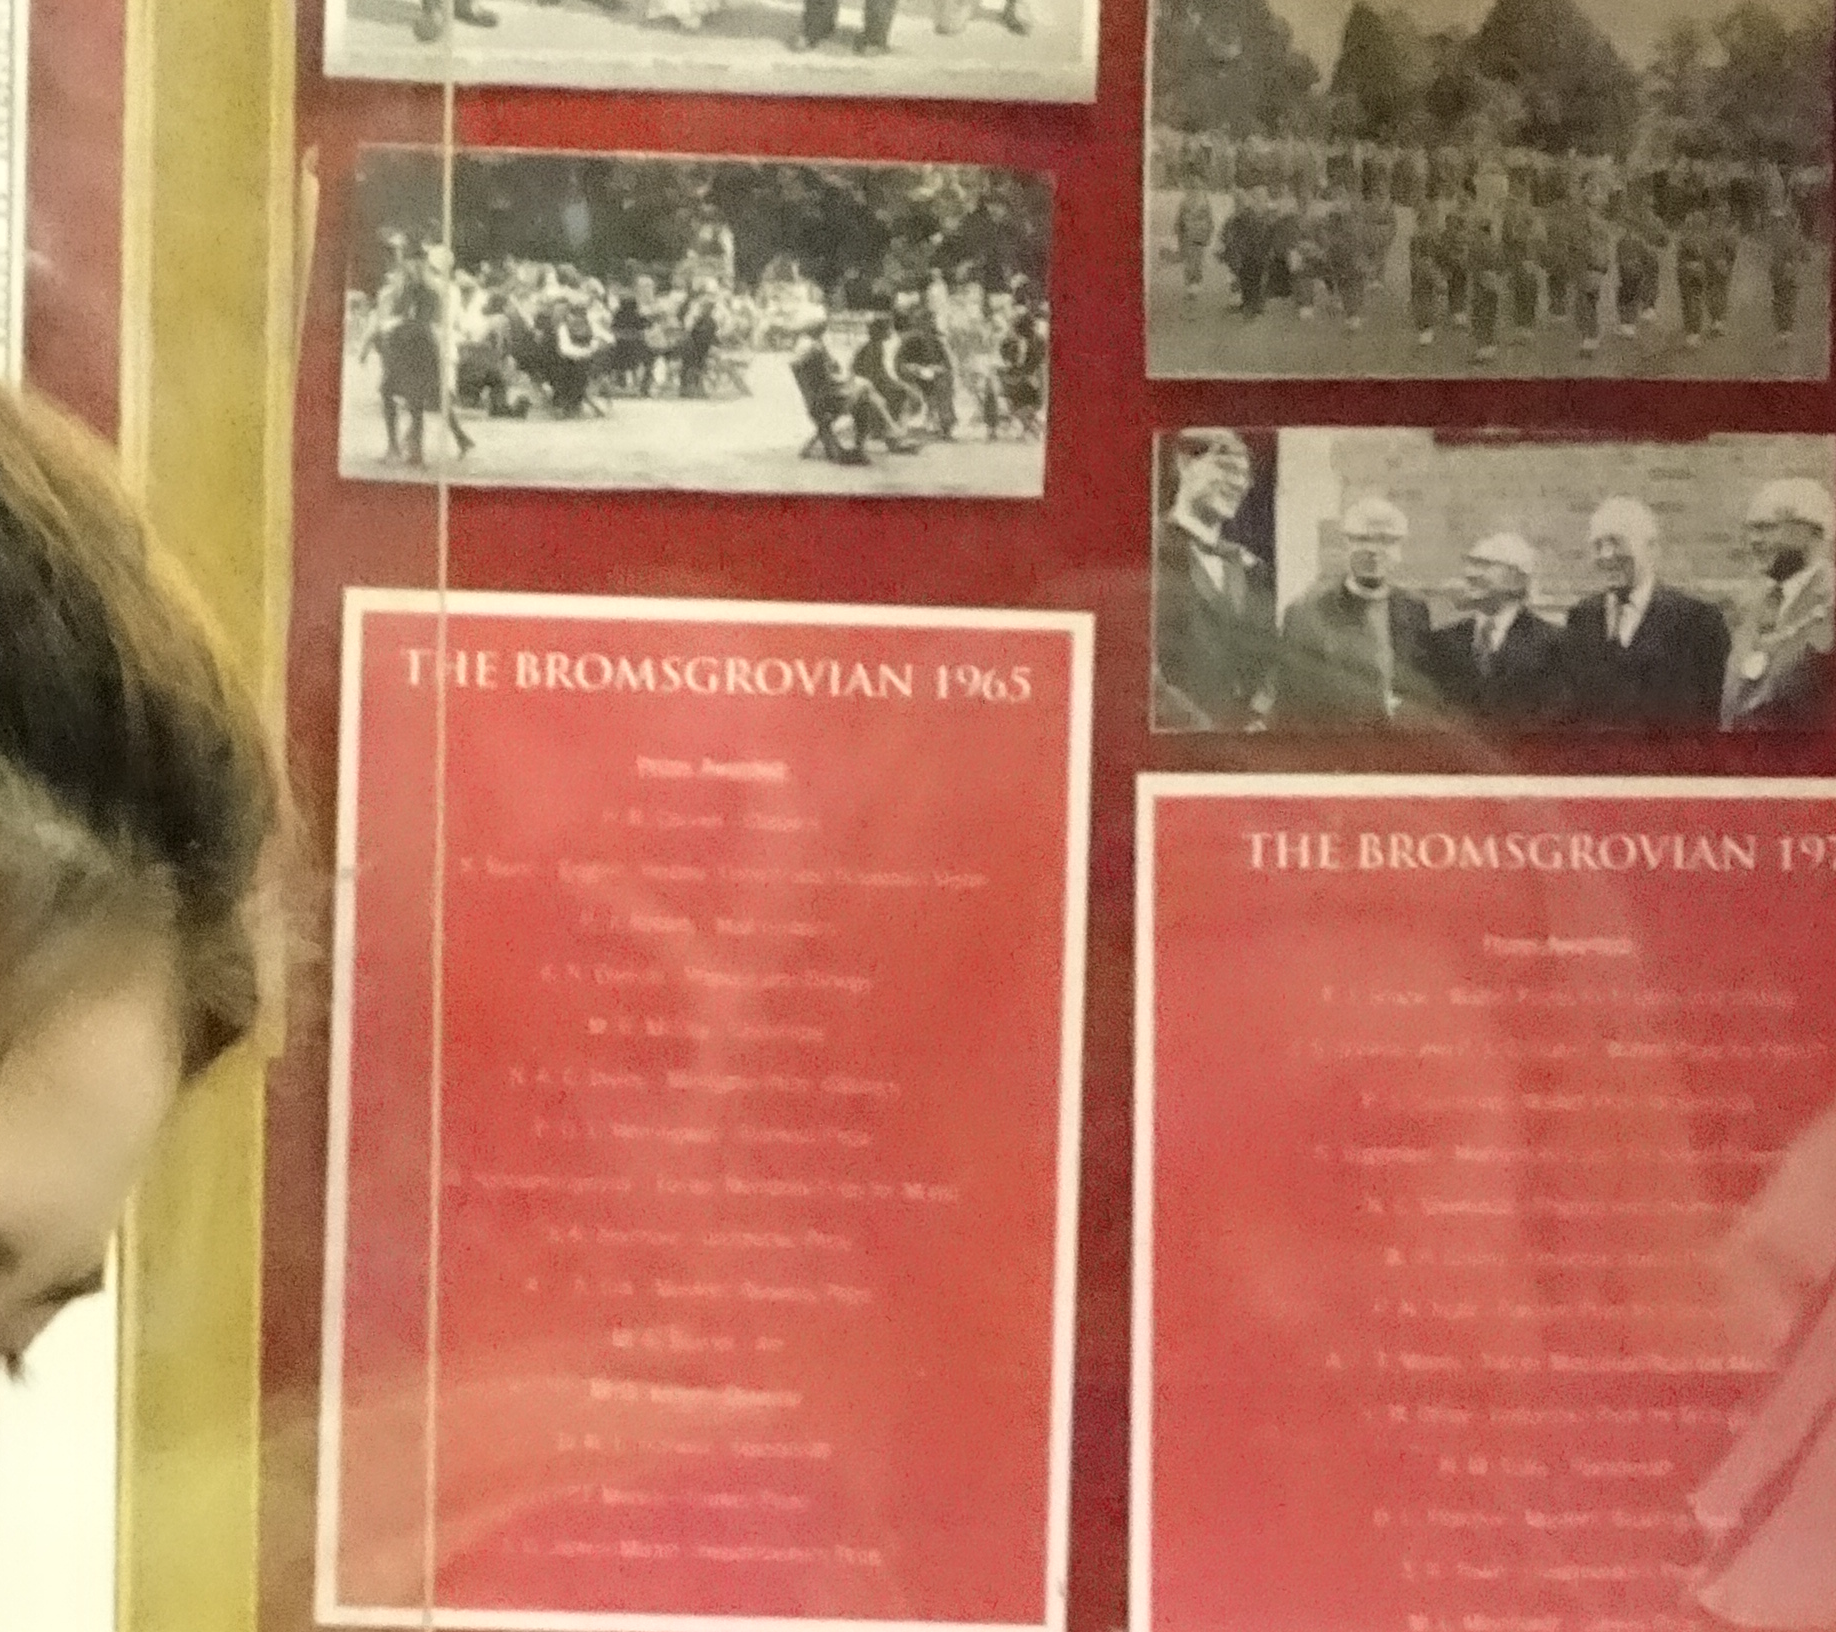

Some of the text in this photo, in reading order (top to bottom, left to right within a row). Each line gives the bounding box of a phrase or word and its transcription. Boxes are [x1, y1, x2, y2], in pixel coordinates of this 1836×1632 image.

[400, 648, 1034, 704] THE BROMSGROVIAN 1965
[1242, 830, 1340, 871] THE
[1358, 830, 1756, 872] BROMSGROVIAN
